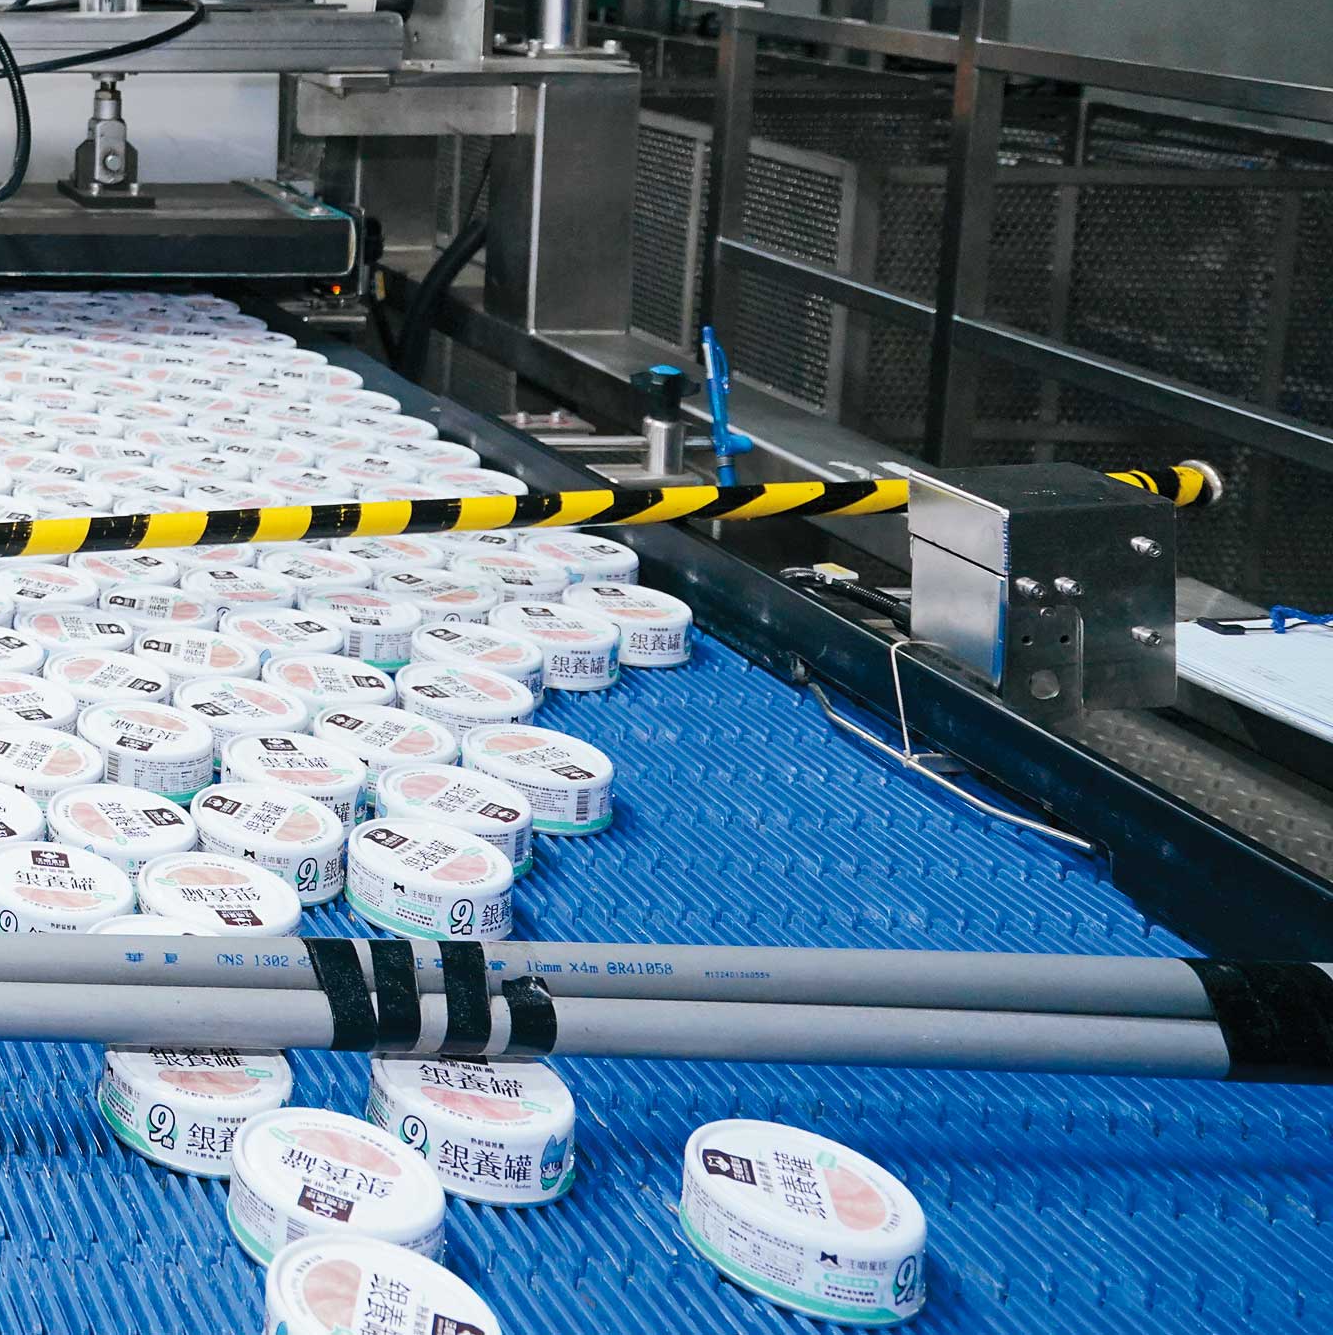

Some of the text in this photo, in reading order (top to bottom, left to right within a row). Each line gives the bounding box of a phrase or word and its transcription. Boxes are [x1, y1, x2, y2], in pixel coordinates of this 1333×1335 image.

[629, 632, 681, 651] 銀養罐
[551, 654, 605, 675] 銀養罐
[216, 953, 244, 966] CNS
[254, 954, 289, 967] 1302
[526, 959, 562, 974] 16mm
[419, 1064, 525, 1099] 銀養罐
[439, 1139, 533, 1182] 銀養罐
